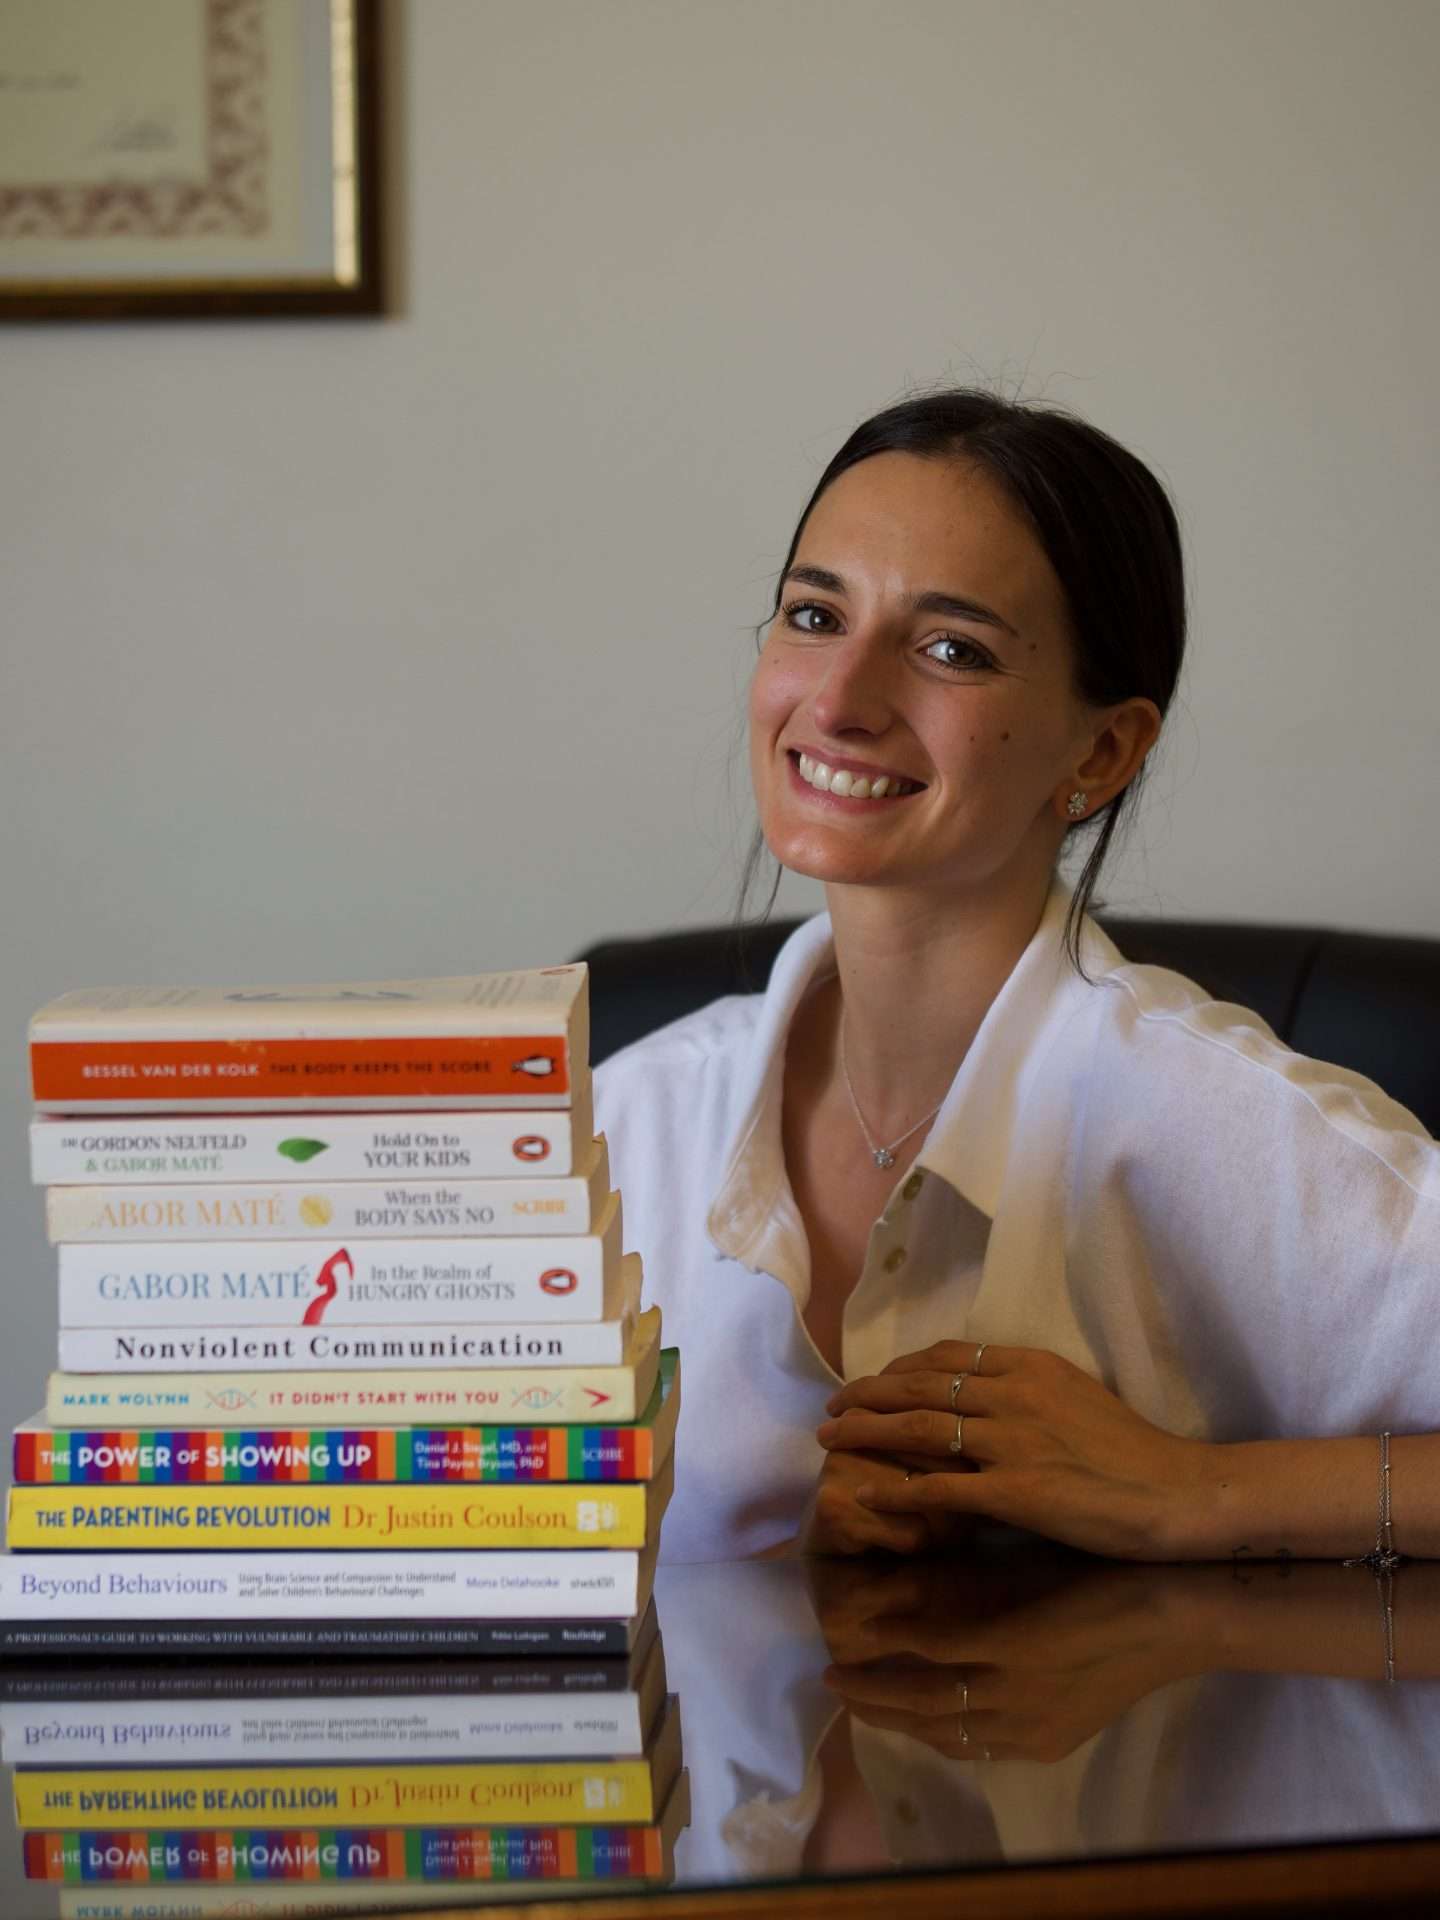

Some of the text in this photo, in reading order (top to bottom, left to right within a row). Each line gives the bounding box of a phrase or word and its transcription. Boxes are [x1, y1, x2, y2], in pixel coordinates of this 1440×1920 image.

[82, 1063, 259, 1078] BESSEL VAN DER KOLK
[269, 1061, 491, 1074] THE BODY KEEPS THE SCORE
[80, 1136, 161, 1152] GORDON
[165, 1134, 247, 1151] NEUFELD
[373, 1133, 460, 1148] Hold On to
[85, 1153, 223, 1172] & GABOR MATÉ
[363, 1150, 471, 1168] YOUR KIDS
[384, 1189, 462, 1206] When the
[94, 1193, 285, 1229] ABOR MATÉ
[355, 1207, 495, 1227] BODY SAYS NO
[370, 1263, 493, 1281] In the Realm of
[98, 1265, 311, 1301] GABOR MATÉ
[347, 1282, 516, 1301] HUNGRY GHOSTS
[115, 1333, 563, 1360] Nonviolent Communication
[63, 1393, 110, 1406] MARK
[269, 1391, 499, 1405] IT DIDN'T START WITH YOU
[40, 1444, 372, 1468] THE POWER OF SHOWING UP
[414, 1441, 449, 1454] Daniel
[500, 1440, 523, 1455] MD,
[525, 1440, 547, 1453] and
[417, 1456, 545, 1471] Tina Payne Bryson, PhD
[36, 1506, 331, 1528] THE PARENTING REVOLUTION
[343, 1504, 378, 1529] Dr
[379, 1504, 454, 1536] Justin
[463, 1503, 567, 1529] Coulson
[20, 1572, 228, 1600] Beyond Behaviours
[239, 1571, 456, 1585] Using Brain Science and Compassion to Understand
[466, 1577, 498, 1589] Mona
[239, 1586, 255, 1598] and
